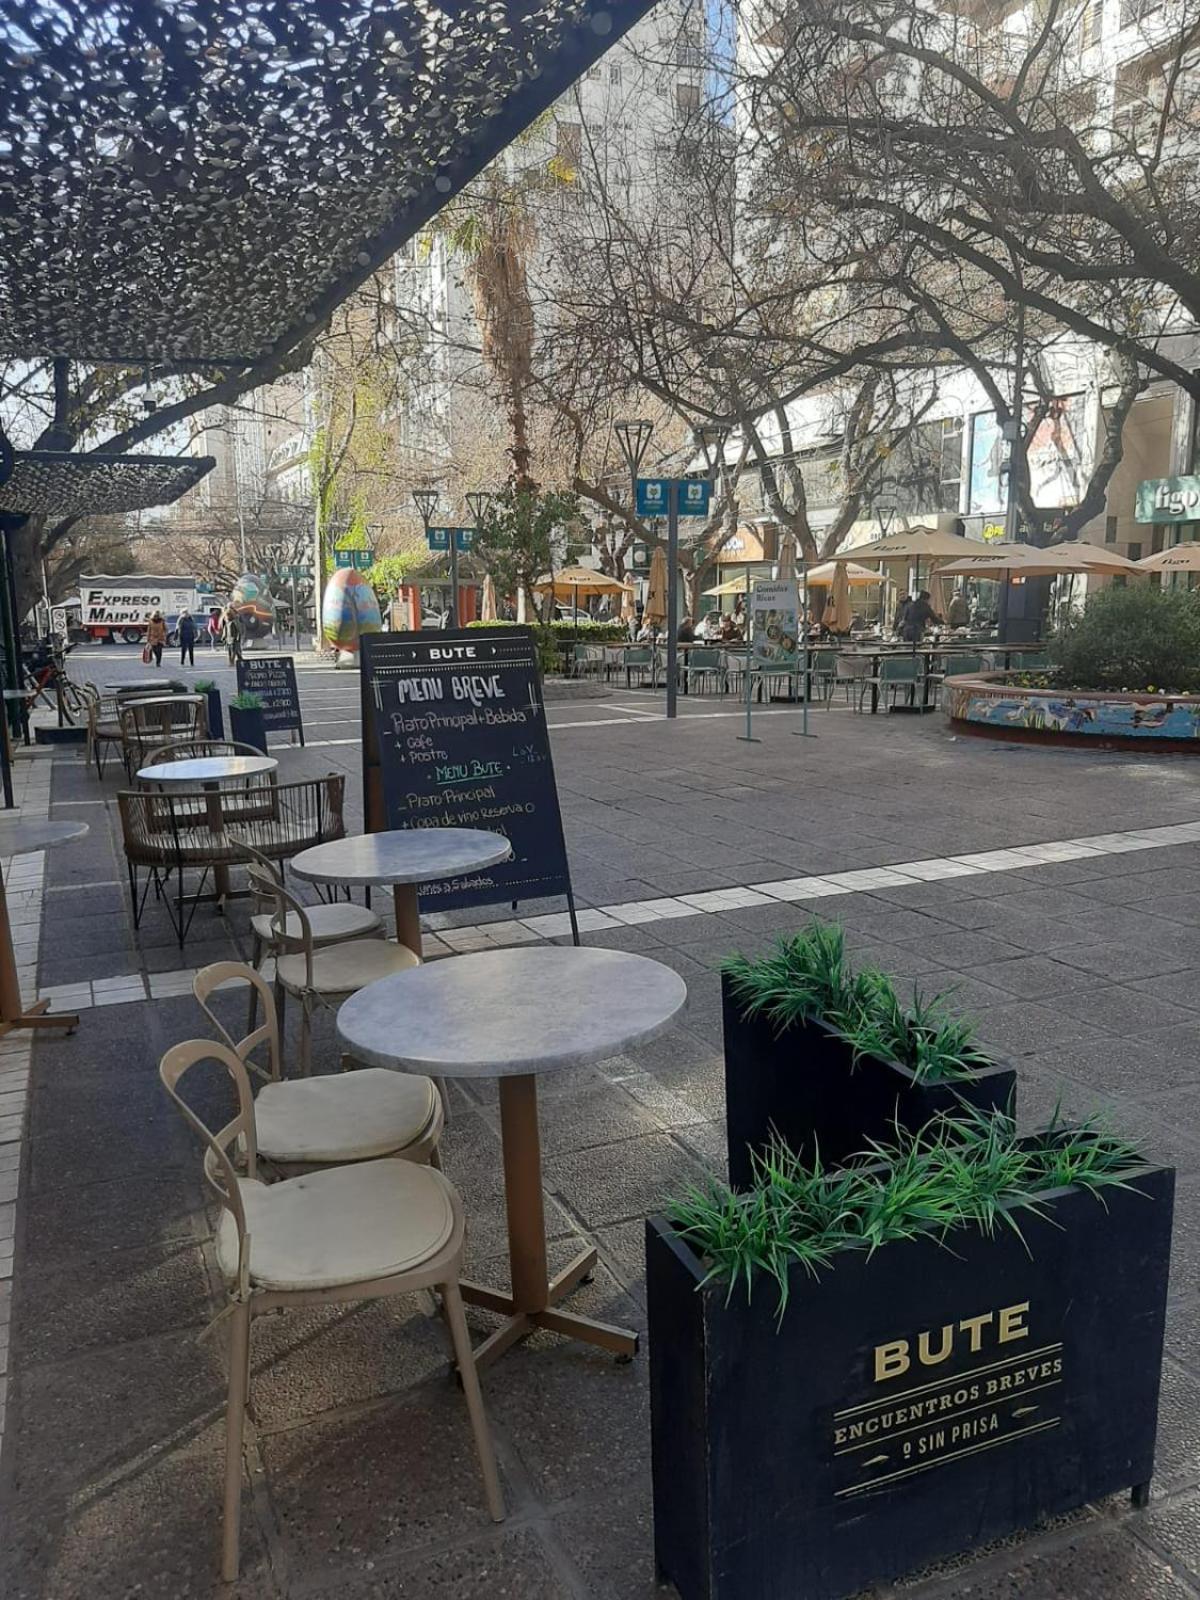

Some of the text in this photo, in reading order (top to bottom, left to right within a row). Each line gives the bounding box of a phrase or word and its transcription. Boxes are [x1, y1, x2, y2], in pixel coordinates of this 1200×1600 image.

[1155, 484, 1198, 514] figo
[87, 590, 161, 606] EXPRESO
[88, 608, 140, 623] MAIPÚ
[250, 660, 281, 670] BUTE
[429, 646, 477, 659] BUTE
[398, 674, 506, 706] MENU BREVE
[874, 1301, 1030, 1383] BUTE
[834, 1358, 1062, 1445] ENCUENTROS BREVES
[918, 1431, 945, 1454] SIN
[952, 1413, 999, 1443] PRISA
